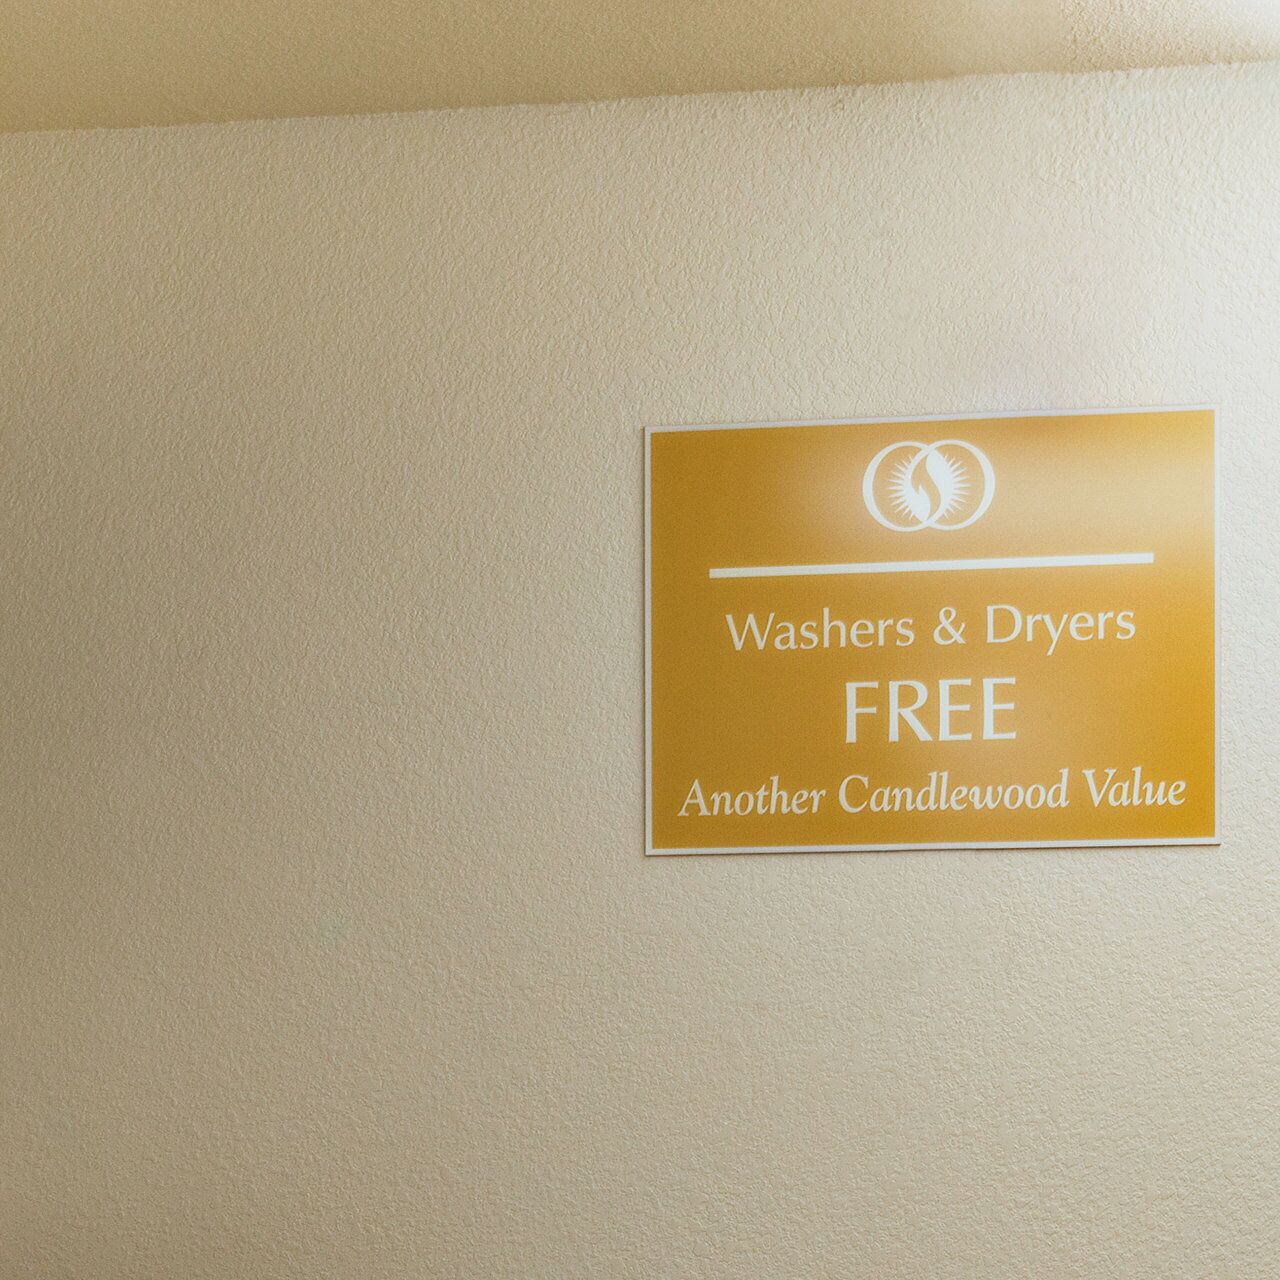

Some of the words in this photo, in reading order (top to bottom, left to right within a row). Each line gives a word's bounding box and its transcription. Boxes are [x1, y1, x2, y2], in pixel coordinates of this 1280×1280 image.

[725, 607, 916, 651] Washers
[933, 606, 967, 645] &
[986, 604, 1136, 656] Dryers
[844, 677, 1017, 744] FREE
[677, 775, 827, 817] Another
[837, 768, 1070, 814] Candlewood
[1081, 765, 1187, 809] Value
